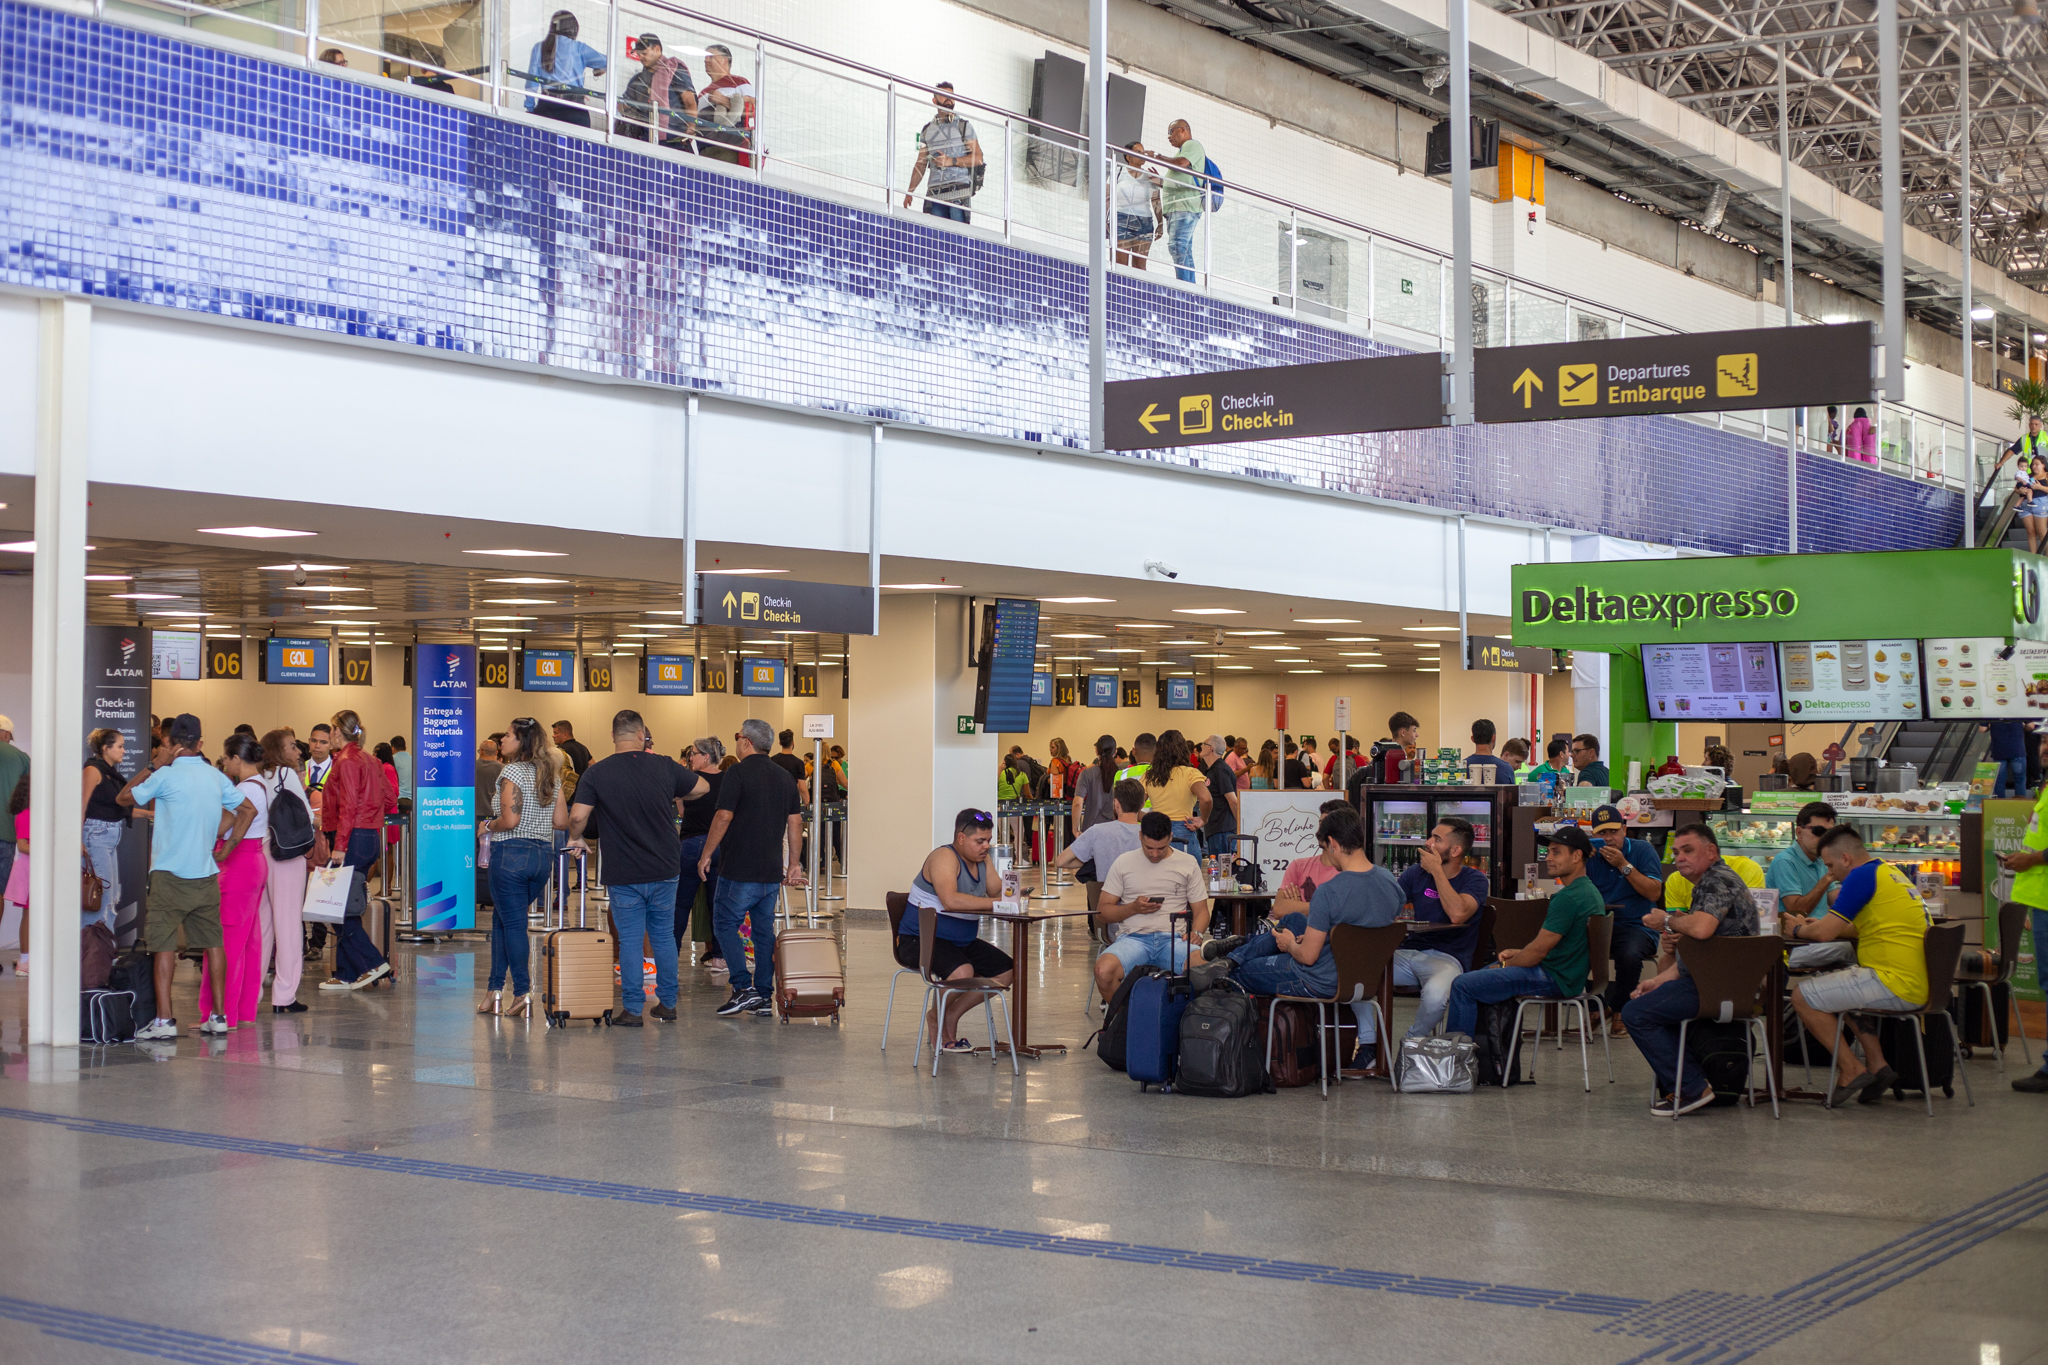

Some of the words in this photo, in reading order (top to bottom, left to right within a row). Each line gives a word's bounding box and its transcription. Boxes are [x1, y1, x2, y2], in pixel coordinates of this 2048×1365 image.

[1608, 364, 1690, 383] Departures
[1221, 392, 1274, 410] Check-in
[1608, 385, 1706, 404] Embarque
[1221, 410, 1293, 431] Check-in
[763, 595, 792, 608] Check-in
[1522, 586, 1798, 629] Deltaexpresso
[763, 609, 801, 623] Check-in
[289, 650, 307, 665] GOL
[1501, 649, 1514, 657] Check-in
[214, 652, 240, 675] 06
[541, 661, 556, 675] GOL
[1501, 658, 1519, 668] Check-in
[106, 668, 143, 677] LATAM
[346, 660, 370, 681] 07
[486, 663, 507, 684] 08
[663, 666, 677, 679] GOL
[757, 669, 769, 681] GOL
[433, 680, 467, 688] LATAM
[590, 668, 610, 688] 09
[707, 671, 725, 690] 10
[800, 676, 815, 694] 11
[1096, 683, 1106, 694] Azul
[1060, 687, 1073, 703] 14
[1127, 689, 1139, 704] 15
[1174, 687, 1183, 698] Azul
[95, 698, 135, 707] Check-in
[1201, 693, 1213, 708] 16
[1804, 699, 1871, 710] Deltaexpresso
[95, 709, 135, 718] Premium
[423, 707, 453, 717] Entrega
[455, 707, 463, 715] de
[423, 717, 459, 727] Bagagem
[423, 727, 463, 737] Etiquetada
[423, 741, 445, 750] Tagged
[423, 750, 449, 759] Baggage
[449, 750, 462, 758] Drop
[422, 797, 464, 806] Assistência
[434, 808, 465, 816] Check-in
[1994, 817, 2015, 825] COMBO
[1264, 817, 1315, 842] Bolinho
[1994, 825, 2015, 837] CAFÉ
